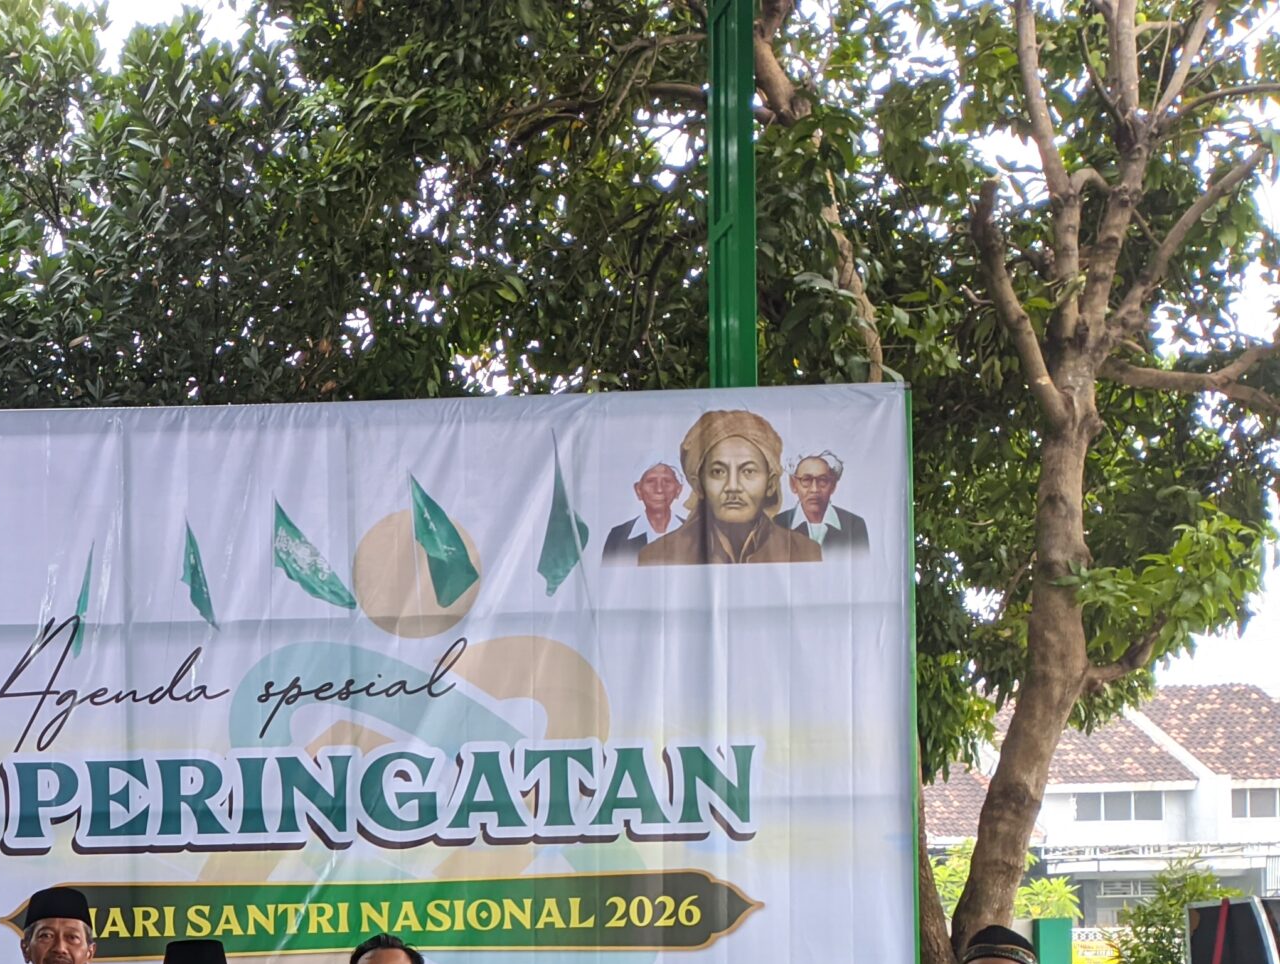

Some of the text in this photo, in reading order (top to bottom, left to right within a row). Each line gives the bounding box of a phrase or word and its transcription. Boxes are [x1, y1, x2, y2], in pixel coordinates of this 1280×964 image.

[257, 637, 468, 738] spesial
[8, 741, 758, 847] PERINGATAN
[186, 902, 349, 938] SANTRI
[360, 896, 595, 932] NASIONAL
[605, 894, 702, 928] 2026
